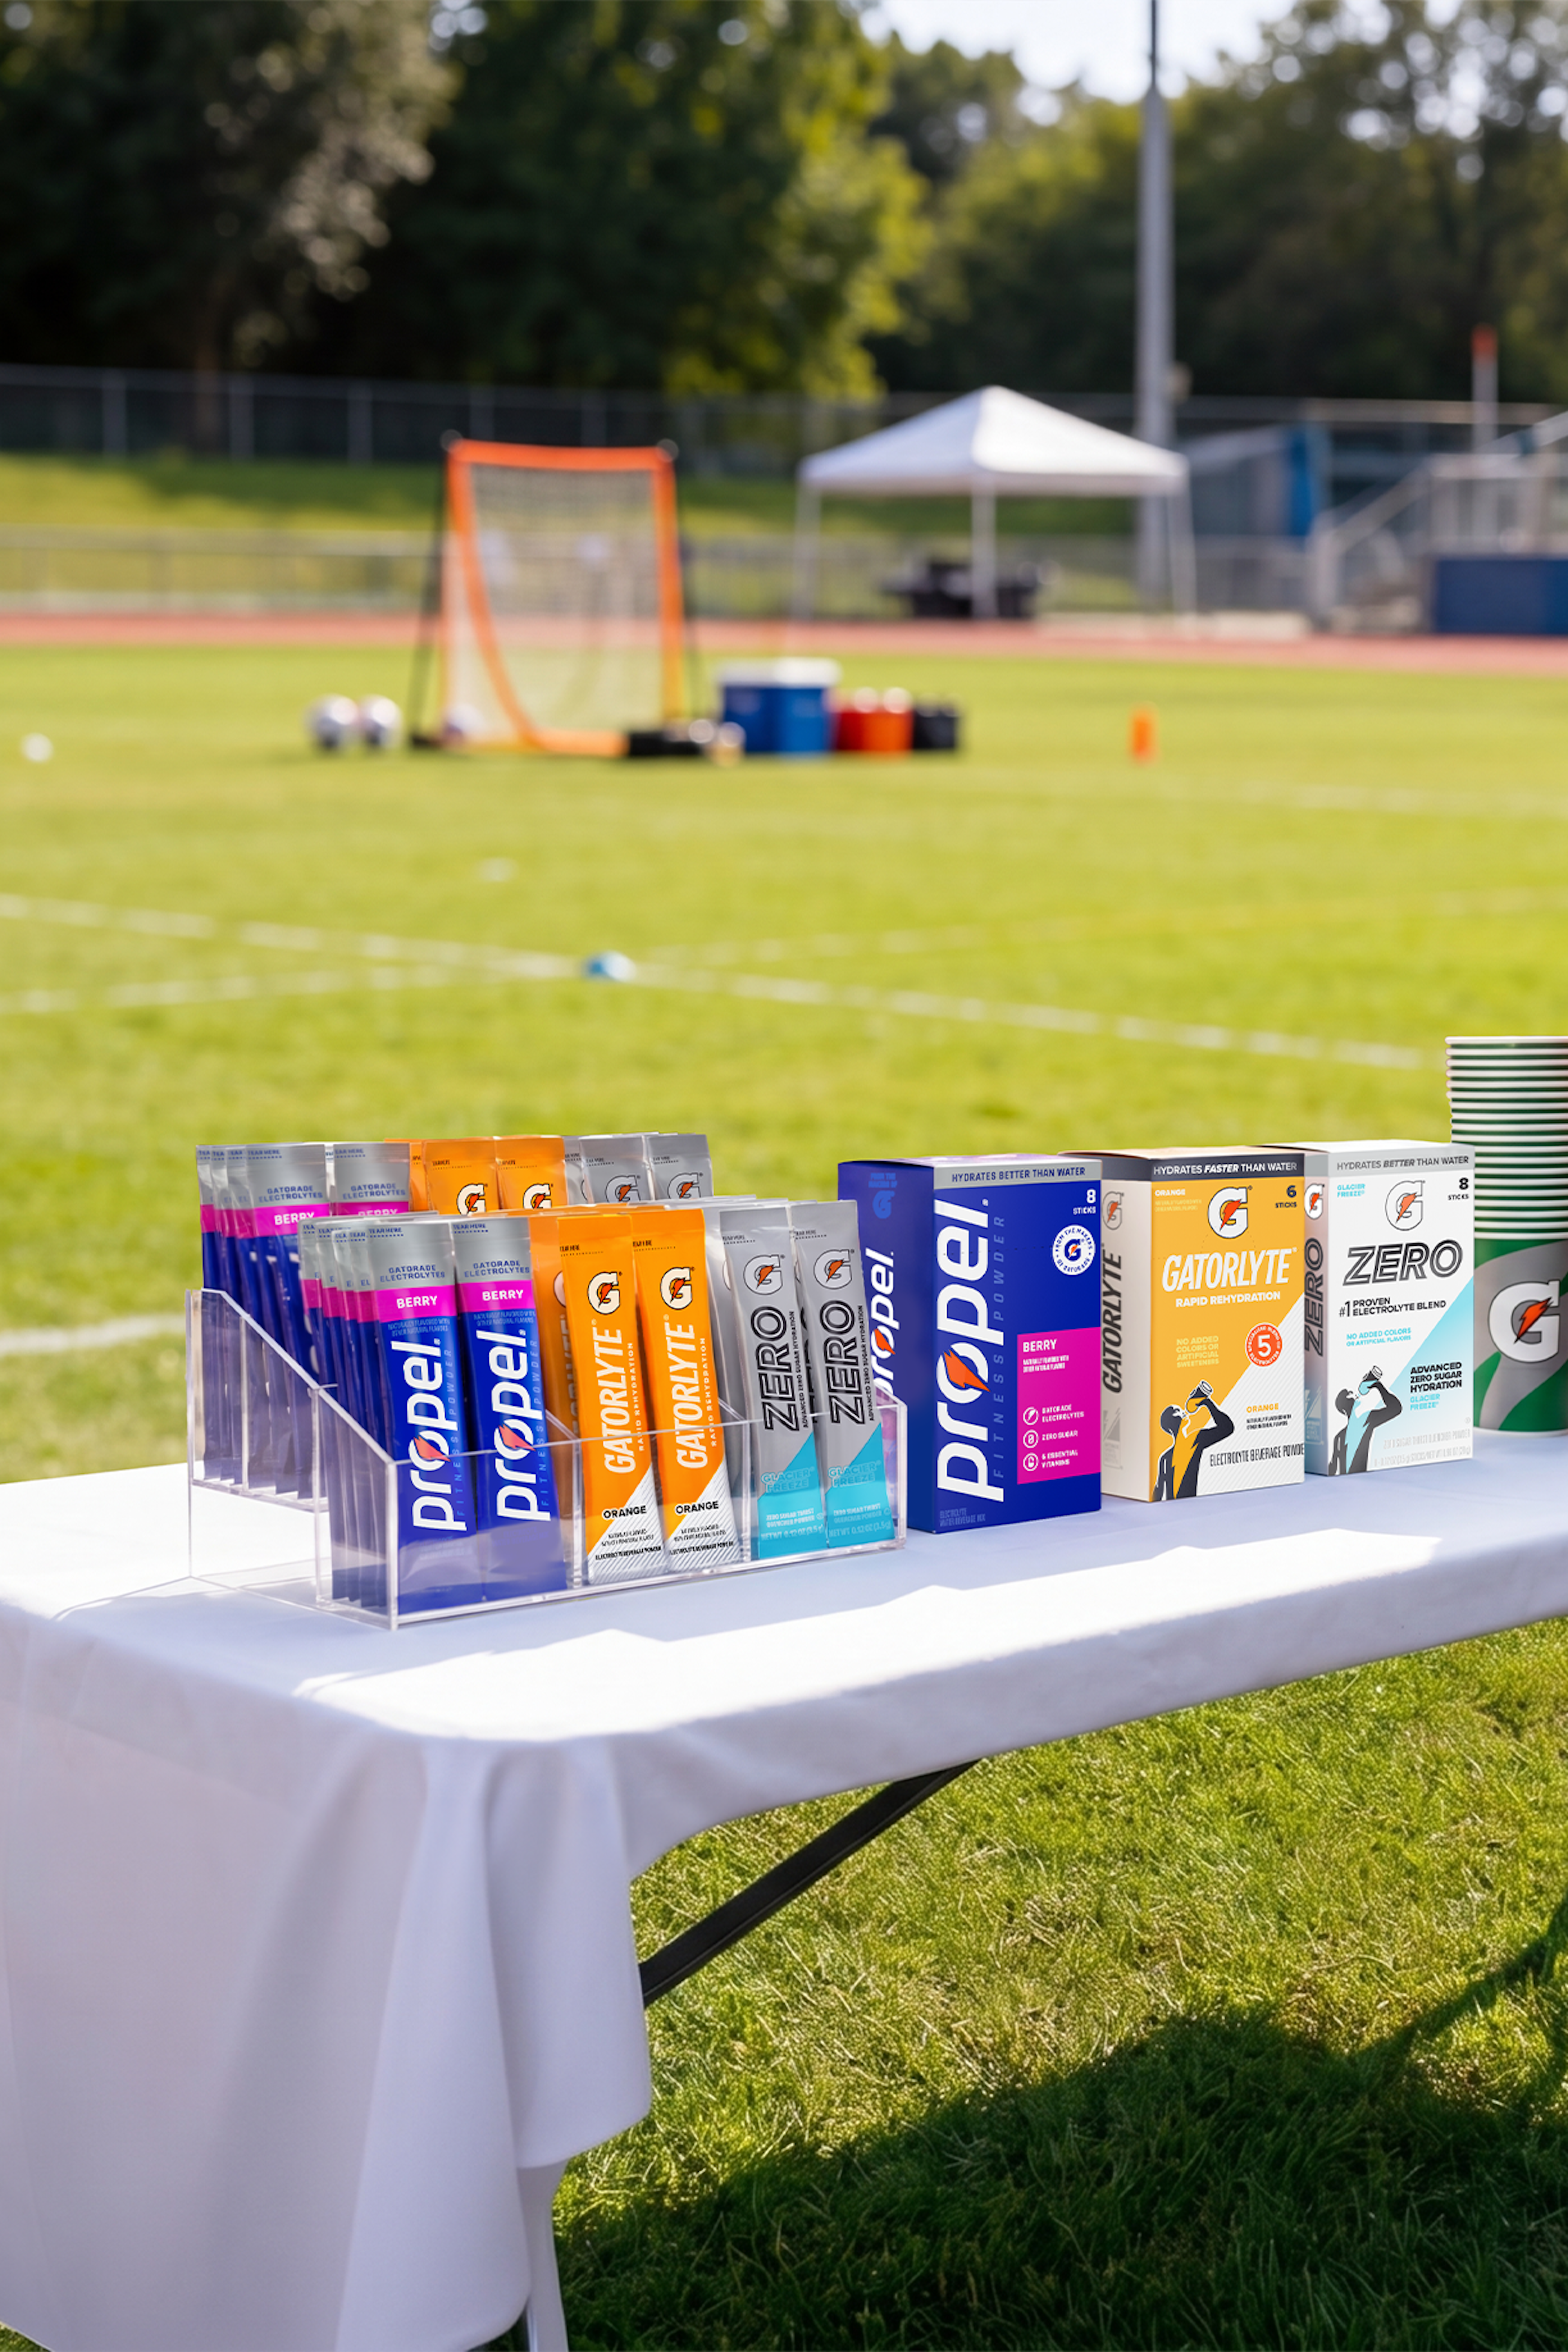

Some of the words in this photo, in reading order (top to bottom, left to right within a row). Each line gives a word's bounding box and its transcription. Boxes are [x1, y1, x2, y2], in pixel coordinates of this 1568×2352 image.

[1153, 1165, 1203, 1176] HYDRATES
[1203, 1163, 1240, 1174] FASTER
[1241, 1162, 1265, 1172] THAN
[1267, 1161, 1297, 1172] WATER
[1337, 1160, 1381, 1171] HYDRATES
[1383, 1158, 1415, 1169] BETTER
[1417, 1157, 1439, 1167] THAN
[1441, 1155, 1469, 1165] WATER
[952, 1172, 996, 1183] HYDRATES
[999, 1170, 1030, 1180] BETTER
[1032, 1168, 1055, 1178] THAN
[1057, 1167, 1086, 1177] WATER
[267, 1185, 313, 1194] GATORADE
[351, 1183, 396, 1192] GATORADE
[1459, 1177, 1469, 1190] 8
[258, 1192, 323, 1203] ELECTROLYTES
[343, 1189, 405, 1200] ELECTROLYTES
[1087, 1189, 1096, 1204] 8
[1155, 1188, 1186, 1197] ORANGE
[1286, 1185, 1296, 1198] 6
[1072, 1206, 1096, 1215] STICKS
[1208, 1187, 1248, 1238] G
[1385, 1180, 1423, 1231] G
[388, 1264, 436, 1274] GATORADE
[473, 1260, 521, 1270] GATORADE
[813, 1249, 852, 1290] G
[993, 1216, 1004, 1321] POWDER
[1343, 1238, 1463, 1286] ZERO
[380, 1271, 445, 1283] ELECTROLYTES
[464, 1266, 530, 1278] ELECTROLYTES
[743, 1254, 783, 1296] G
[1162, 1248, 1292, 1292] GATORLYTE
[482, 1289, 524, 1301] BERRY
[587, 1271, 621, 1315] G
[659, 1266, 693, 1310] G
[396, 1295, 438, 1309] BERRY
[1176, 1294, 1208, 1307] RAPID
[1210, 1291, 1281, 1305] REHYDRATION
[1304, 1237, 1323, 1357] ZERO
[1352, 1296, 1390, 1307] PROVEN
[1339, 1301, 1351, 1317] #1
[1352, 1302, 1415, 1317] ELECTROLYTE
[1417, 1300, 1446, 1310] BLEND
[1102, 1249, 1123, 1394] GATORLYTE
[1488, 1279, 1560, 1363] G
[1176, 1337, 1189, 1346] NO
[1190, 1335, 1219, 1345] ADDED
[1346, 1332, 1357, 1341] NO
[1359, 1330, 1383, 1339] ADDED
[1384, 1327, 1412, 1336] COLORS
[1354, 1337, 1386, 1346] ARTIFICIAL
[1387, 1334, 1411, 1343] FLAVORS
[933, 1199, 1004, 1502] propel
[1022, 1339, 1057, 1353] BERRY
[1176, 1344, 1207, 1353] COLORS
[1258, 1334, 1271, 1357] 5
[820, 1300, 865, 1425] ZERO
[1176, 1351, 1219, 1361] ARTIFICIAL
[1176, 1358, 1219, 1368] SWEETENERS
[530, 1340, 541, 1404] POWDER
[751, 1305, 800, 1432] ZERO
[1410, 1361, 1462, 1375] ADVANCED
[444, 1349, 457, 1416] POWDER
[1410, 1374, 1432, 1384] ZERO
[1434, 1371, 1462, 1381] SUGAR
[1410, 1379, 1462, 1394] HYDRATION
[592, 1326, 636, 1474] GATORLYTE
[664, 1322, 708, 1469] GATORLYTE
[1410, 1393, 1441, 1403] GLACIER
[1246, 1403, 1279, 1413] ORANGE
[993, 1354, 1004, 1478] FITNESS
[476, 1330, 551, 1521] propel
[390, 1340, 468, 1531] propel
[1210, 1448, 1249, 1468] ELECTROLYTE
[1250, 1446, 1282, 1463] BEVERAGE
[603, 1505, 647, 1519] ORANGE
[676, 1500, 719, 1515] ORANGE
